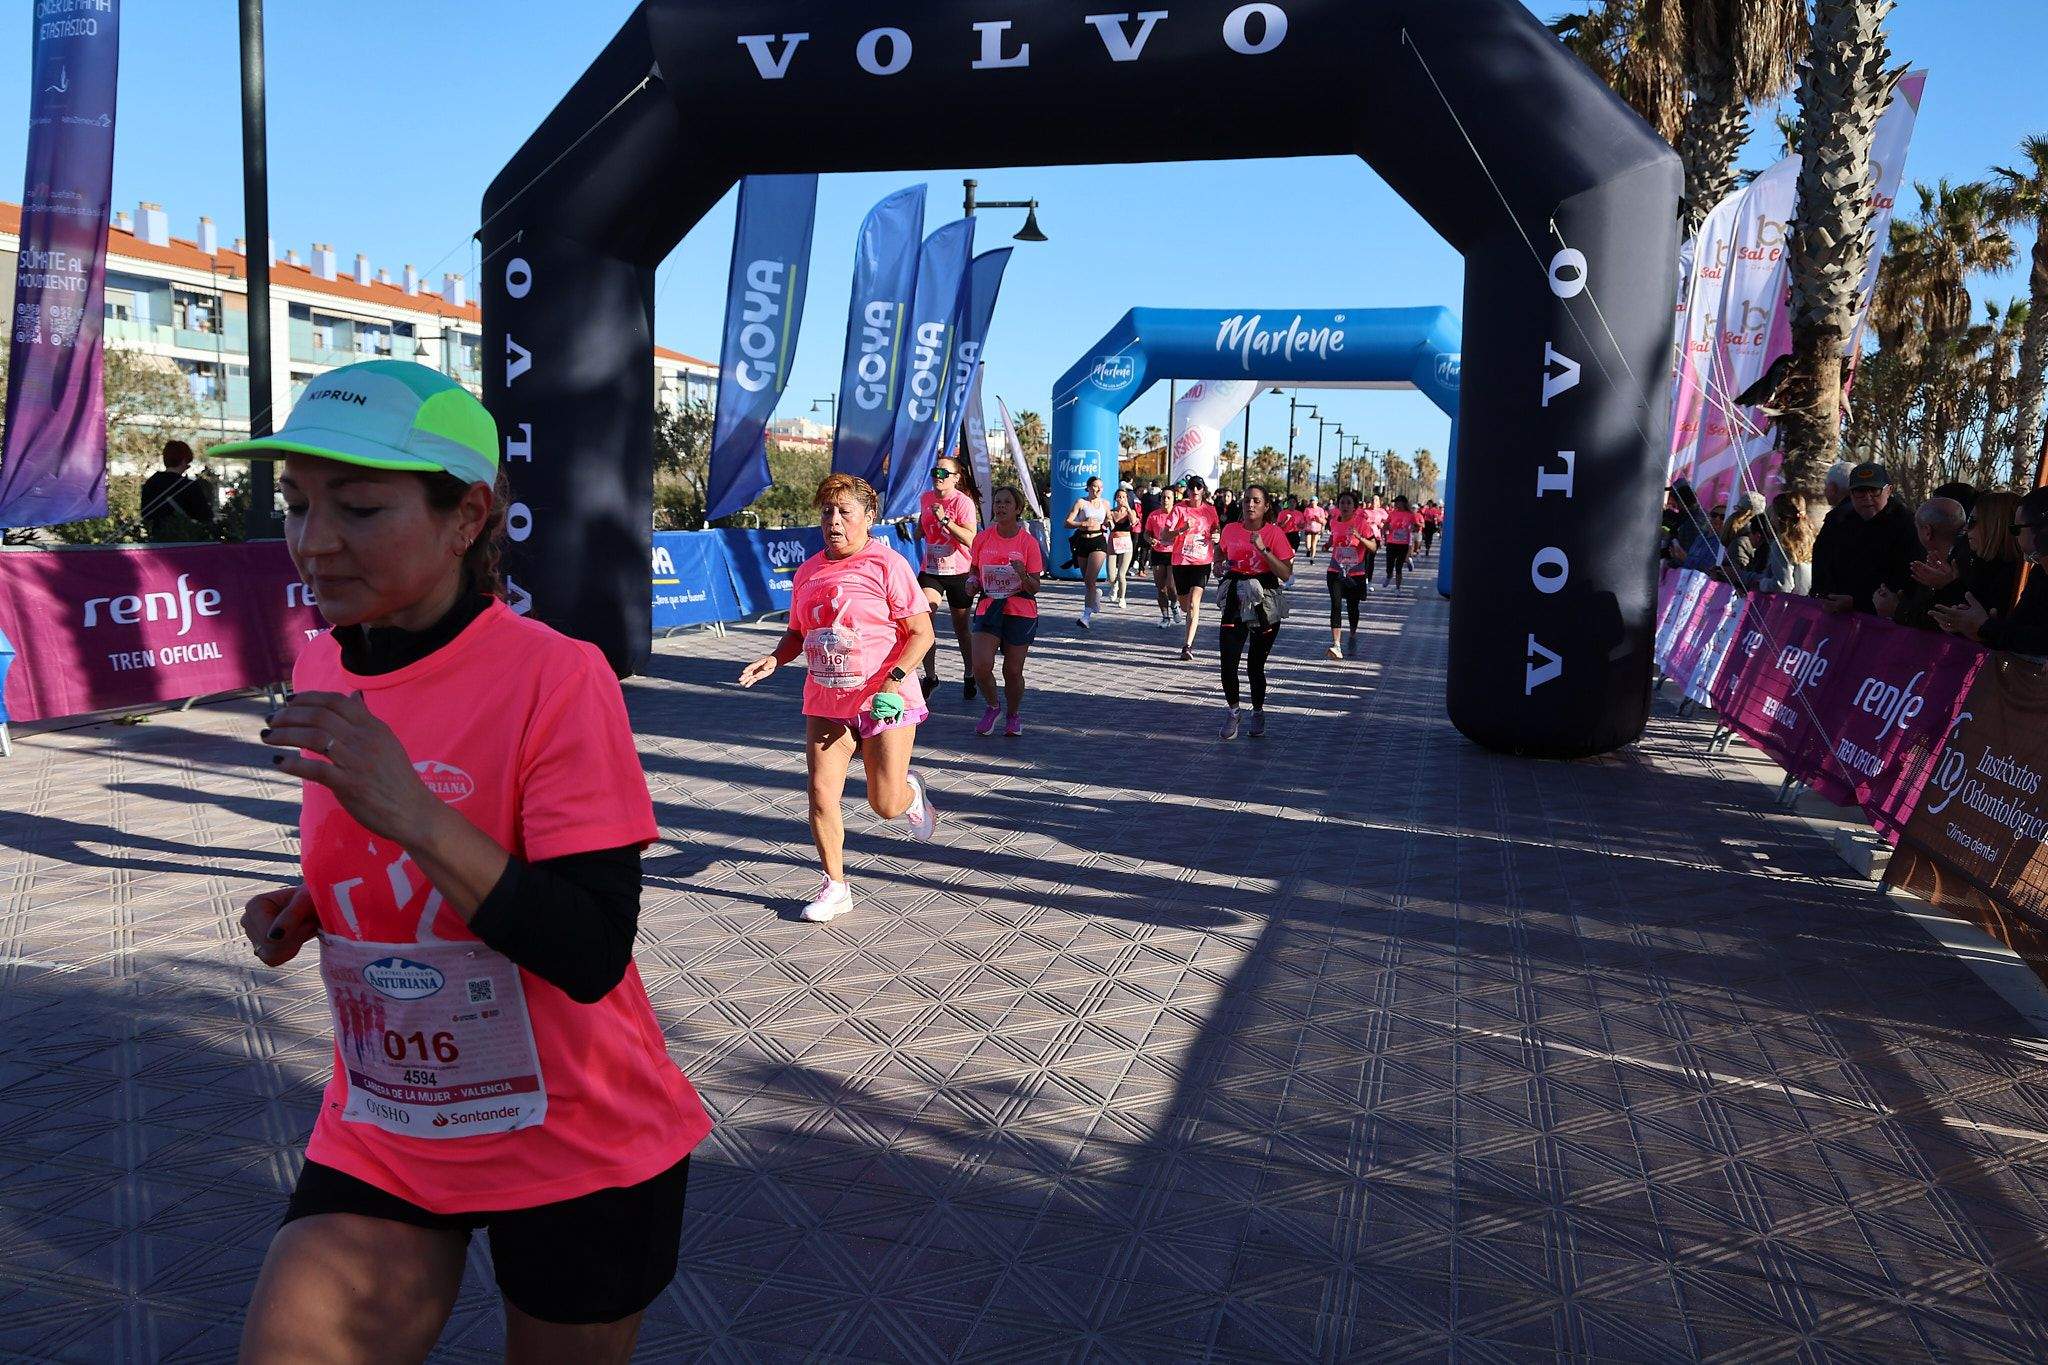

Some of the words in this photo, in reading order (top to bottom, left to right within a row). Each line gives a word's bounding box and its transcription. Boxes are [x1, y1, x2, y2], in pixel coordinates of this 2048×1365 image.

[737, 2, 1288, 79] VOLVO
[68, 257, 87, 273] AL
[735, 259, 784, 392] GOYA
[855, 300, 894, 410] GOYA
[1216, 314, 1346, 371] Marlene
[908, 321, 945, 422] GOYA
[1093, 362, 1131, 381] Marlene
[308, 389, 367, 406] KIPRUN
[505, 257, 532, 616] VOLVO
[1059, 458, 1098, 478] Marlene
[1525, 247, 1588, 696] VOLVO
[83, 573, 222, 636] renfe
[108, 649, 156, 672] TREN
[159, 641, 222, 666] OFICIAL
[1775, 637, 1830, 697] renfe
[1852, 670, 1925, 740] renfe
[1836, 737, 1858, 765] TREN
[1976, 745, 2041, 794] Institutos
[1970, 837, 2000, 863] dental
[369, 971, 440, 990] ASTURIANA
[383, 1029, 460, 1063] 016
[391, 1089, 403, 1099] DE
[405, 1090, 416, 1100] LA
[418, 1091, 452, 1102] MUJER
[460, 1082, 513, 1098] VALENCIA
[403, 1070, 438, 1086] 4594
[366, 1098, 410, 1124] OYSHO
[450, 1105, 520, 1125] Santander
